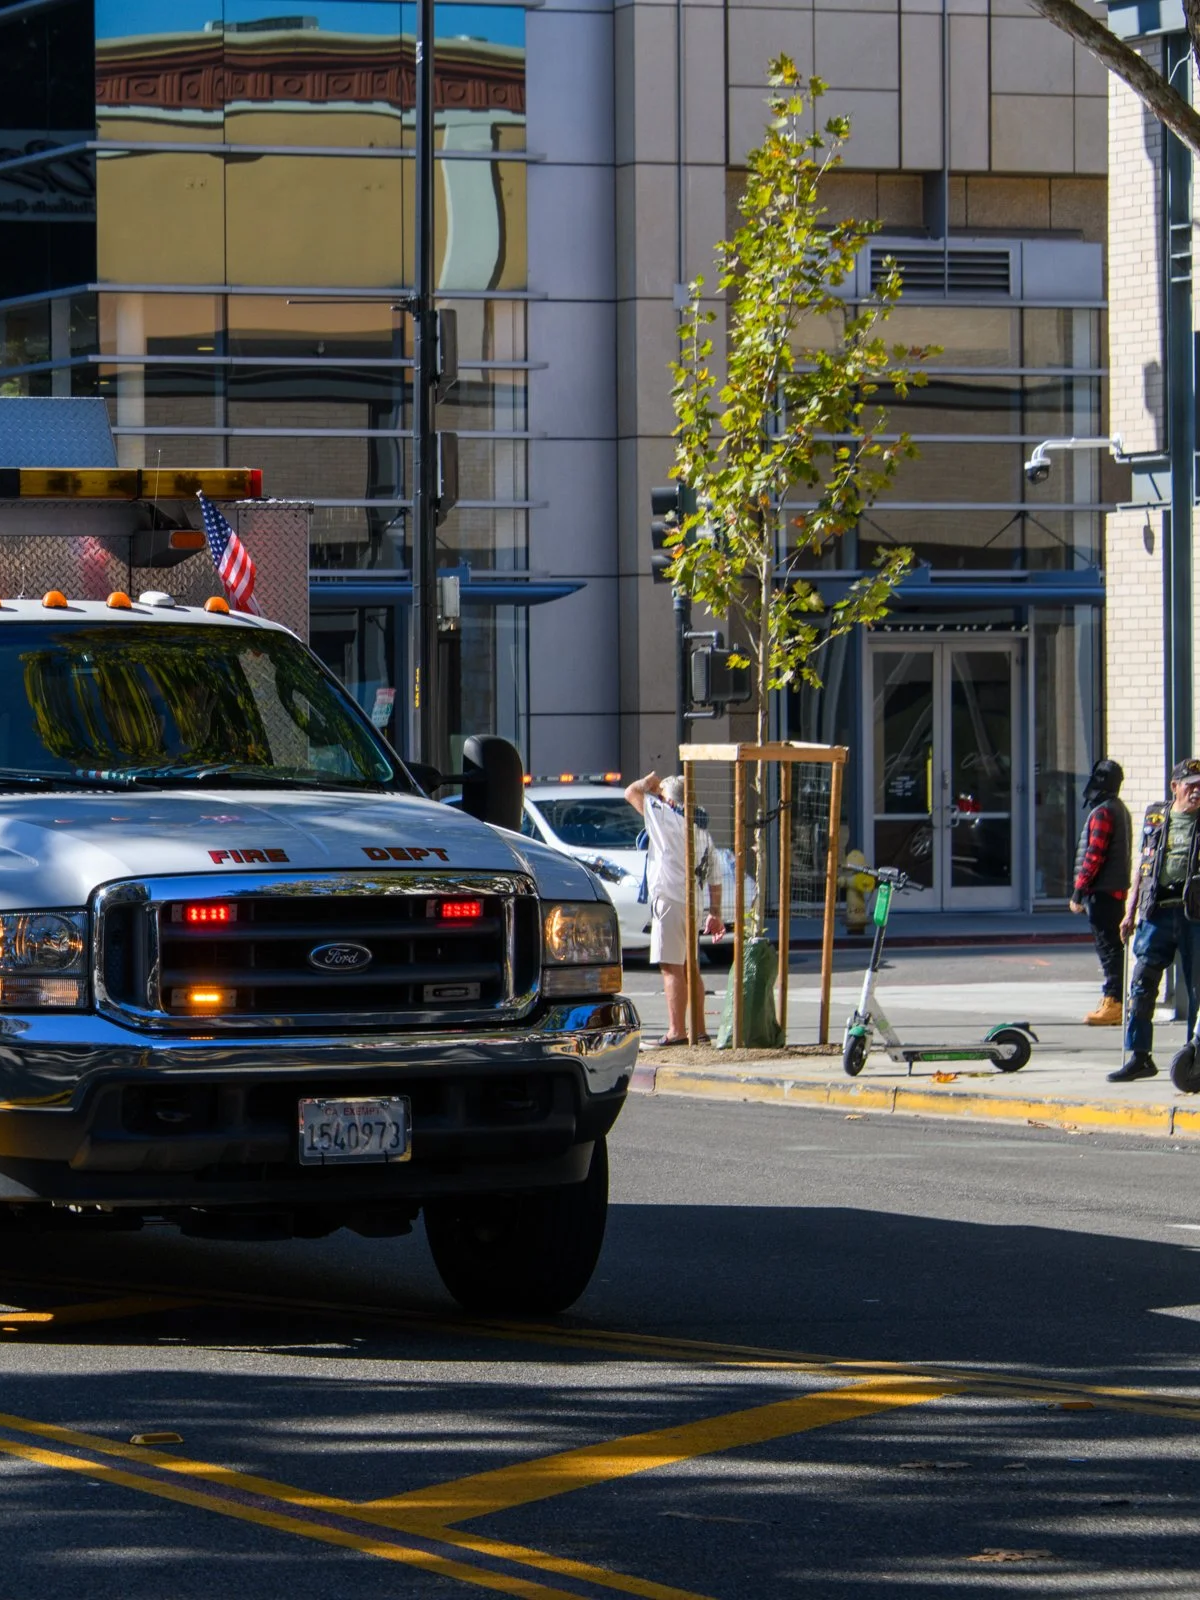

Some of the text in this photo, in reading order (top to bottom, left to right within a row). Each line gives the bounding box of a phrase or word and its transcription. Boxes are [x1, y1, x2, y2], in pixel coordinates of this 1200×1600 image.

[207, 847, 450, 865] FIRE DEPT
[324, 947, 359, 965] Ford
[306, 1121, 401, 1151] 1540973
